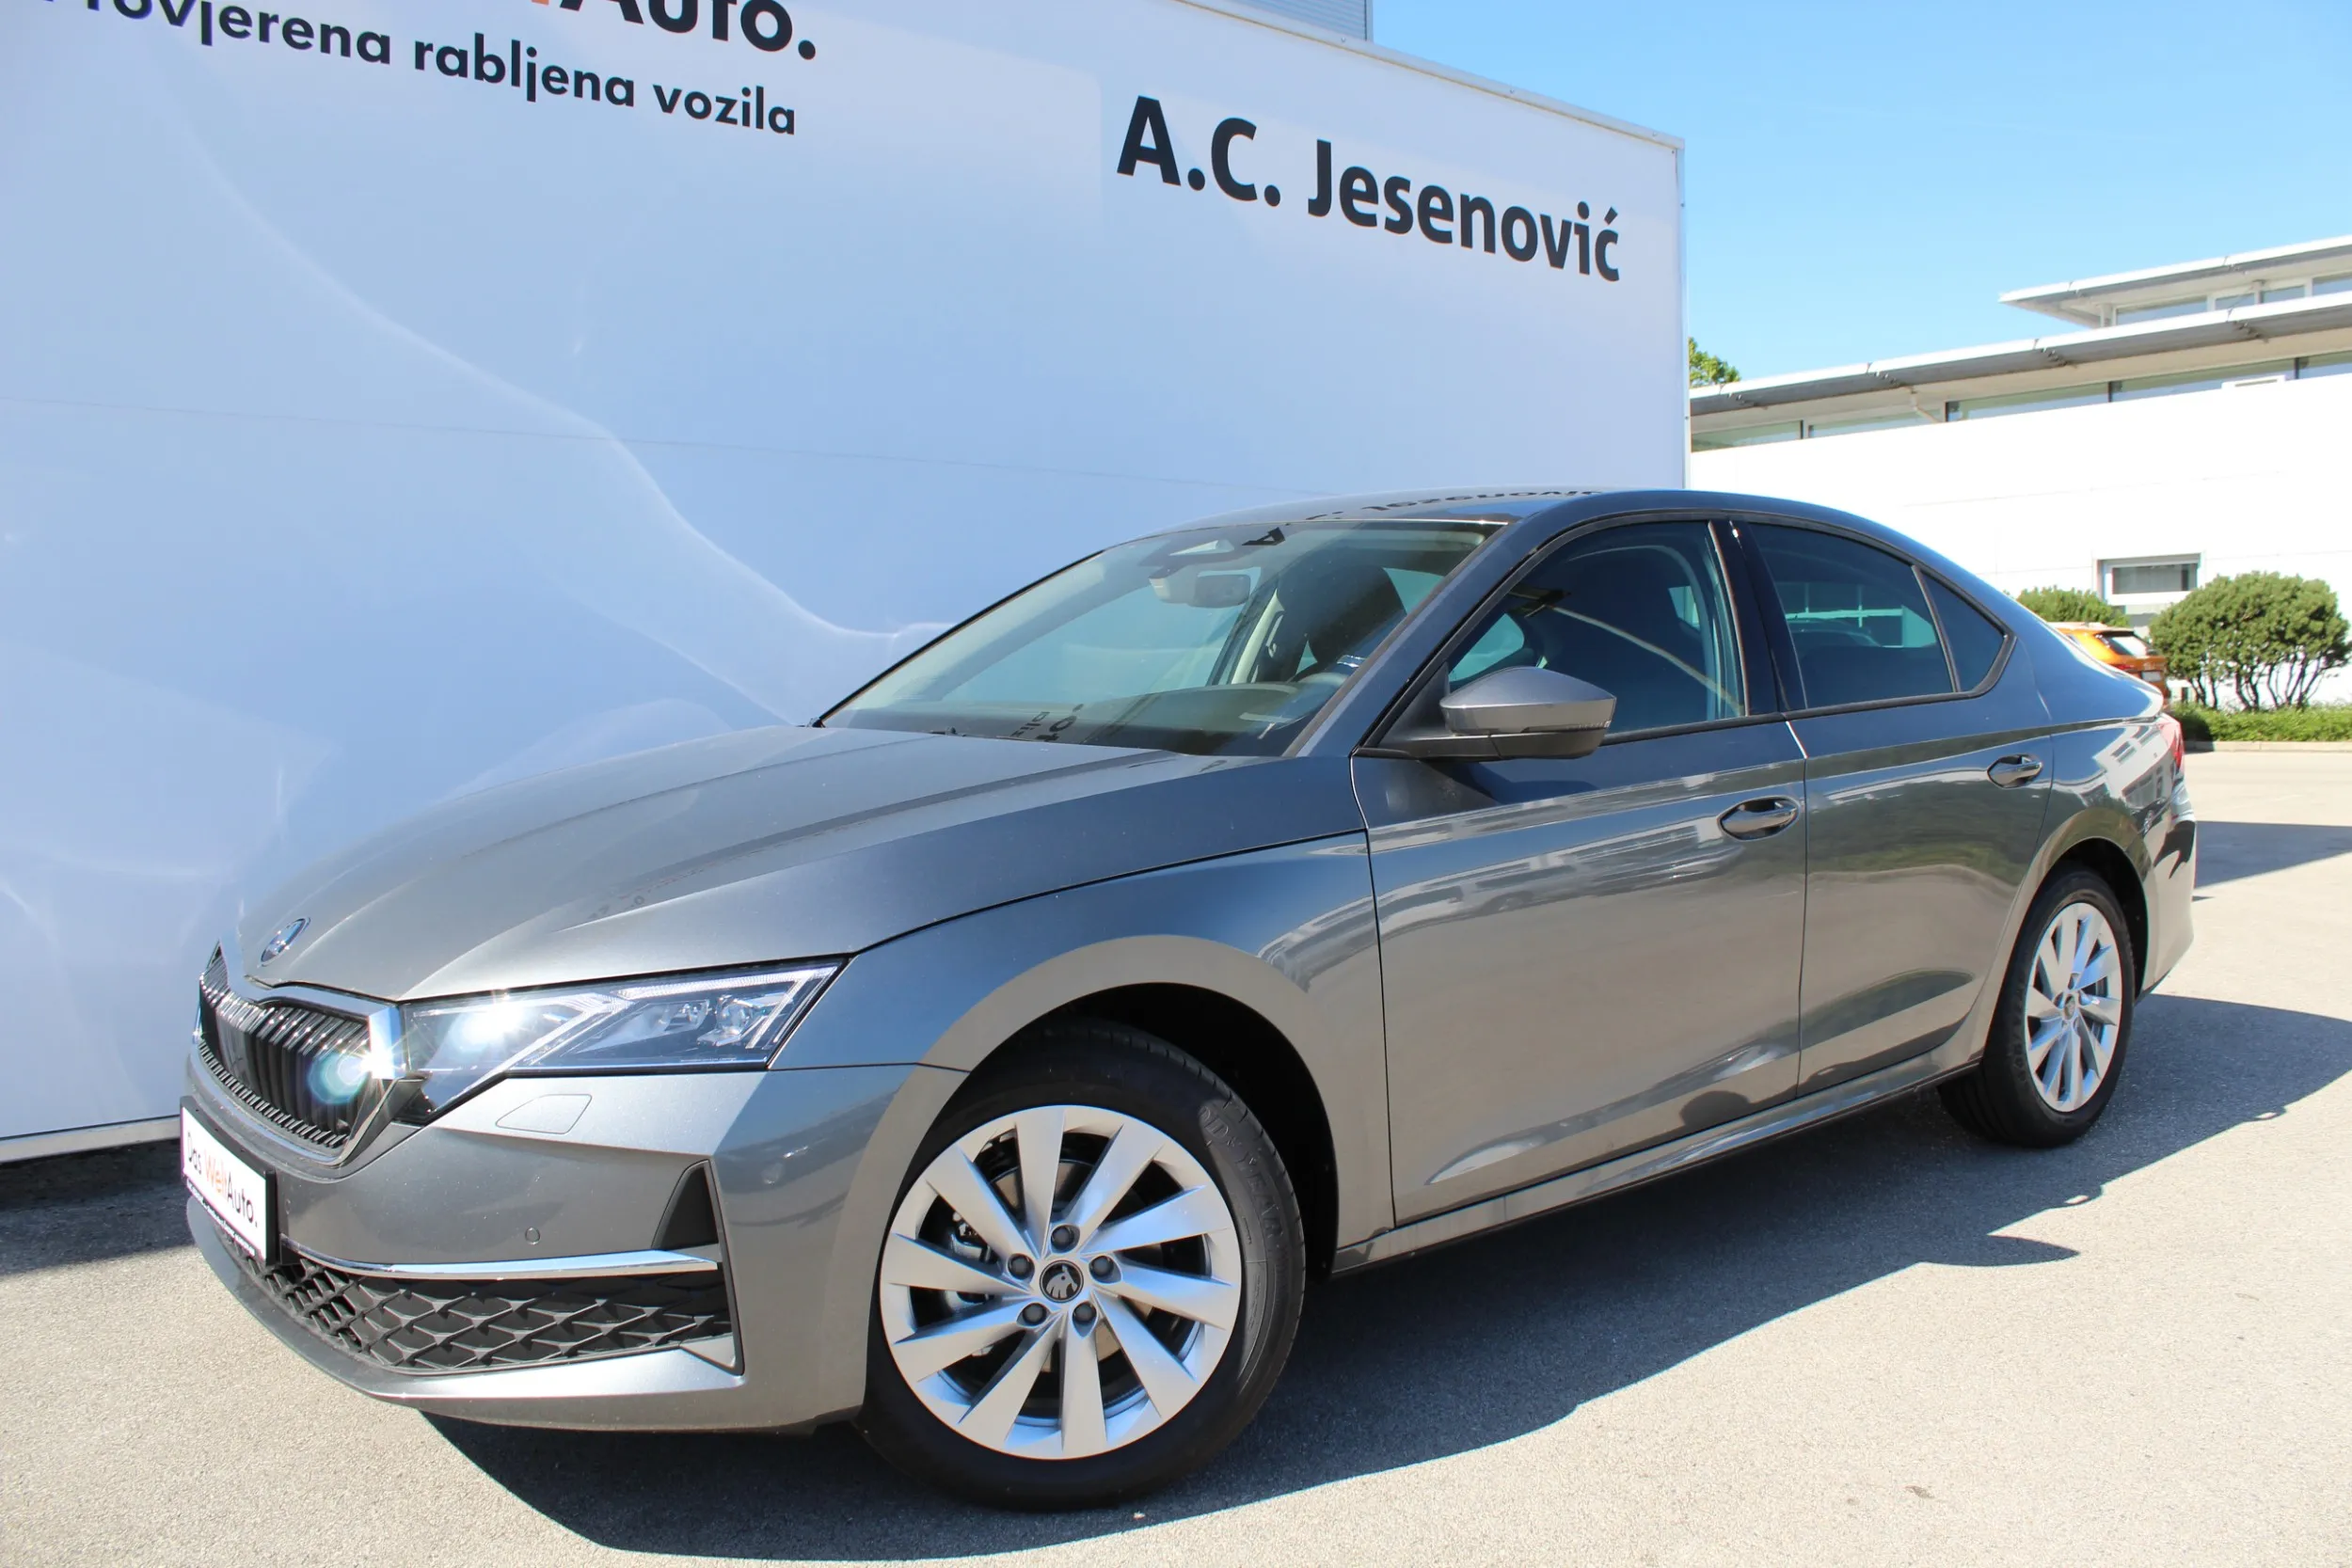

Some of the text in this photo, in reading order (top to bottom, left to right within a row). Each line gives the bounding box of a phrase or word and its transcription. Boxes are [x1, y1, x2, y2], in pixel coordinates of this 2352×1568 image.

[44, 0, 796, 135] ovjerena rabljena vozila
[1117, 95, 1620, 282] A.C. Jesenović
